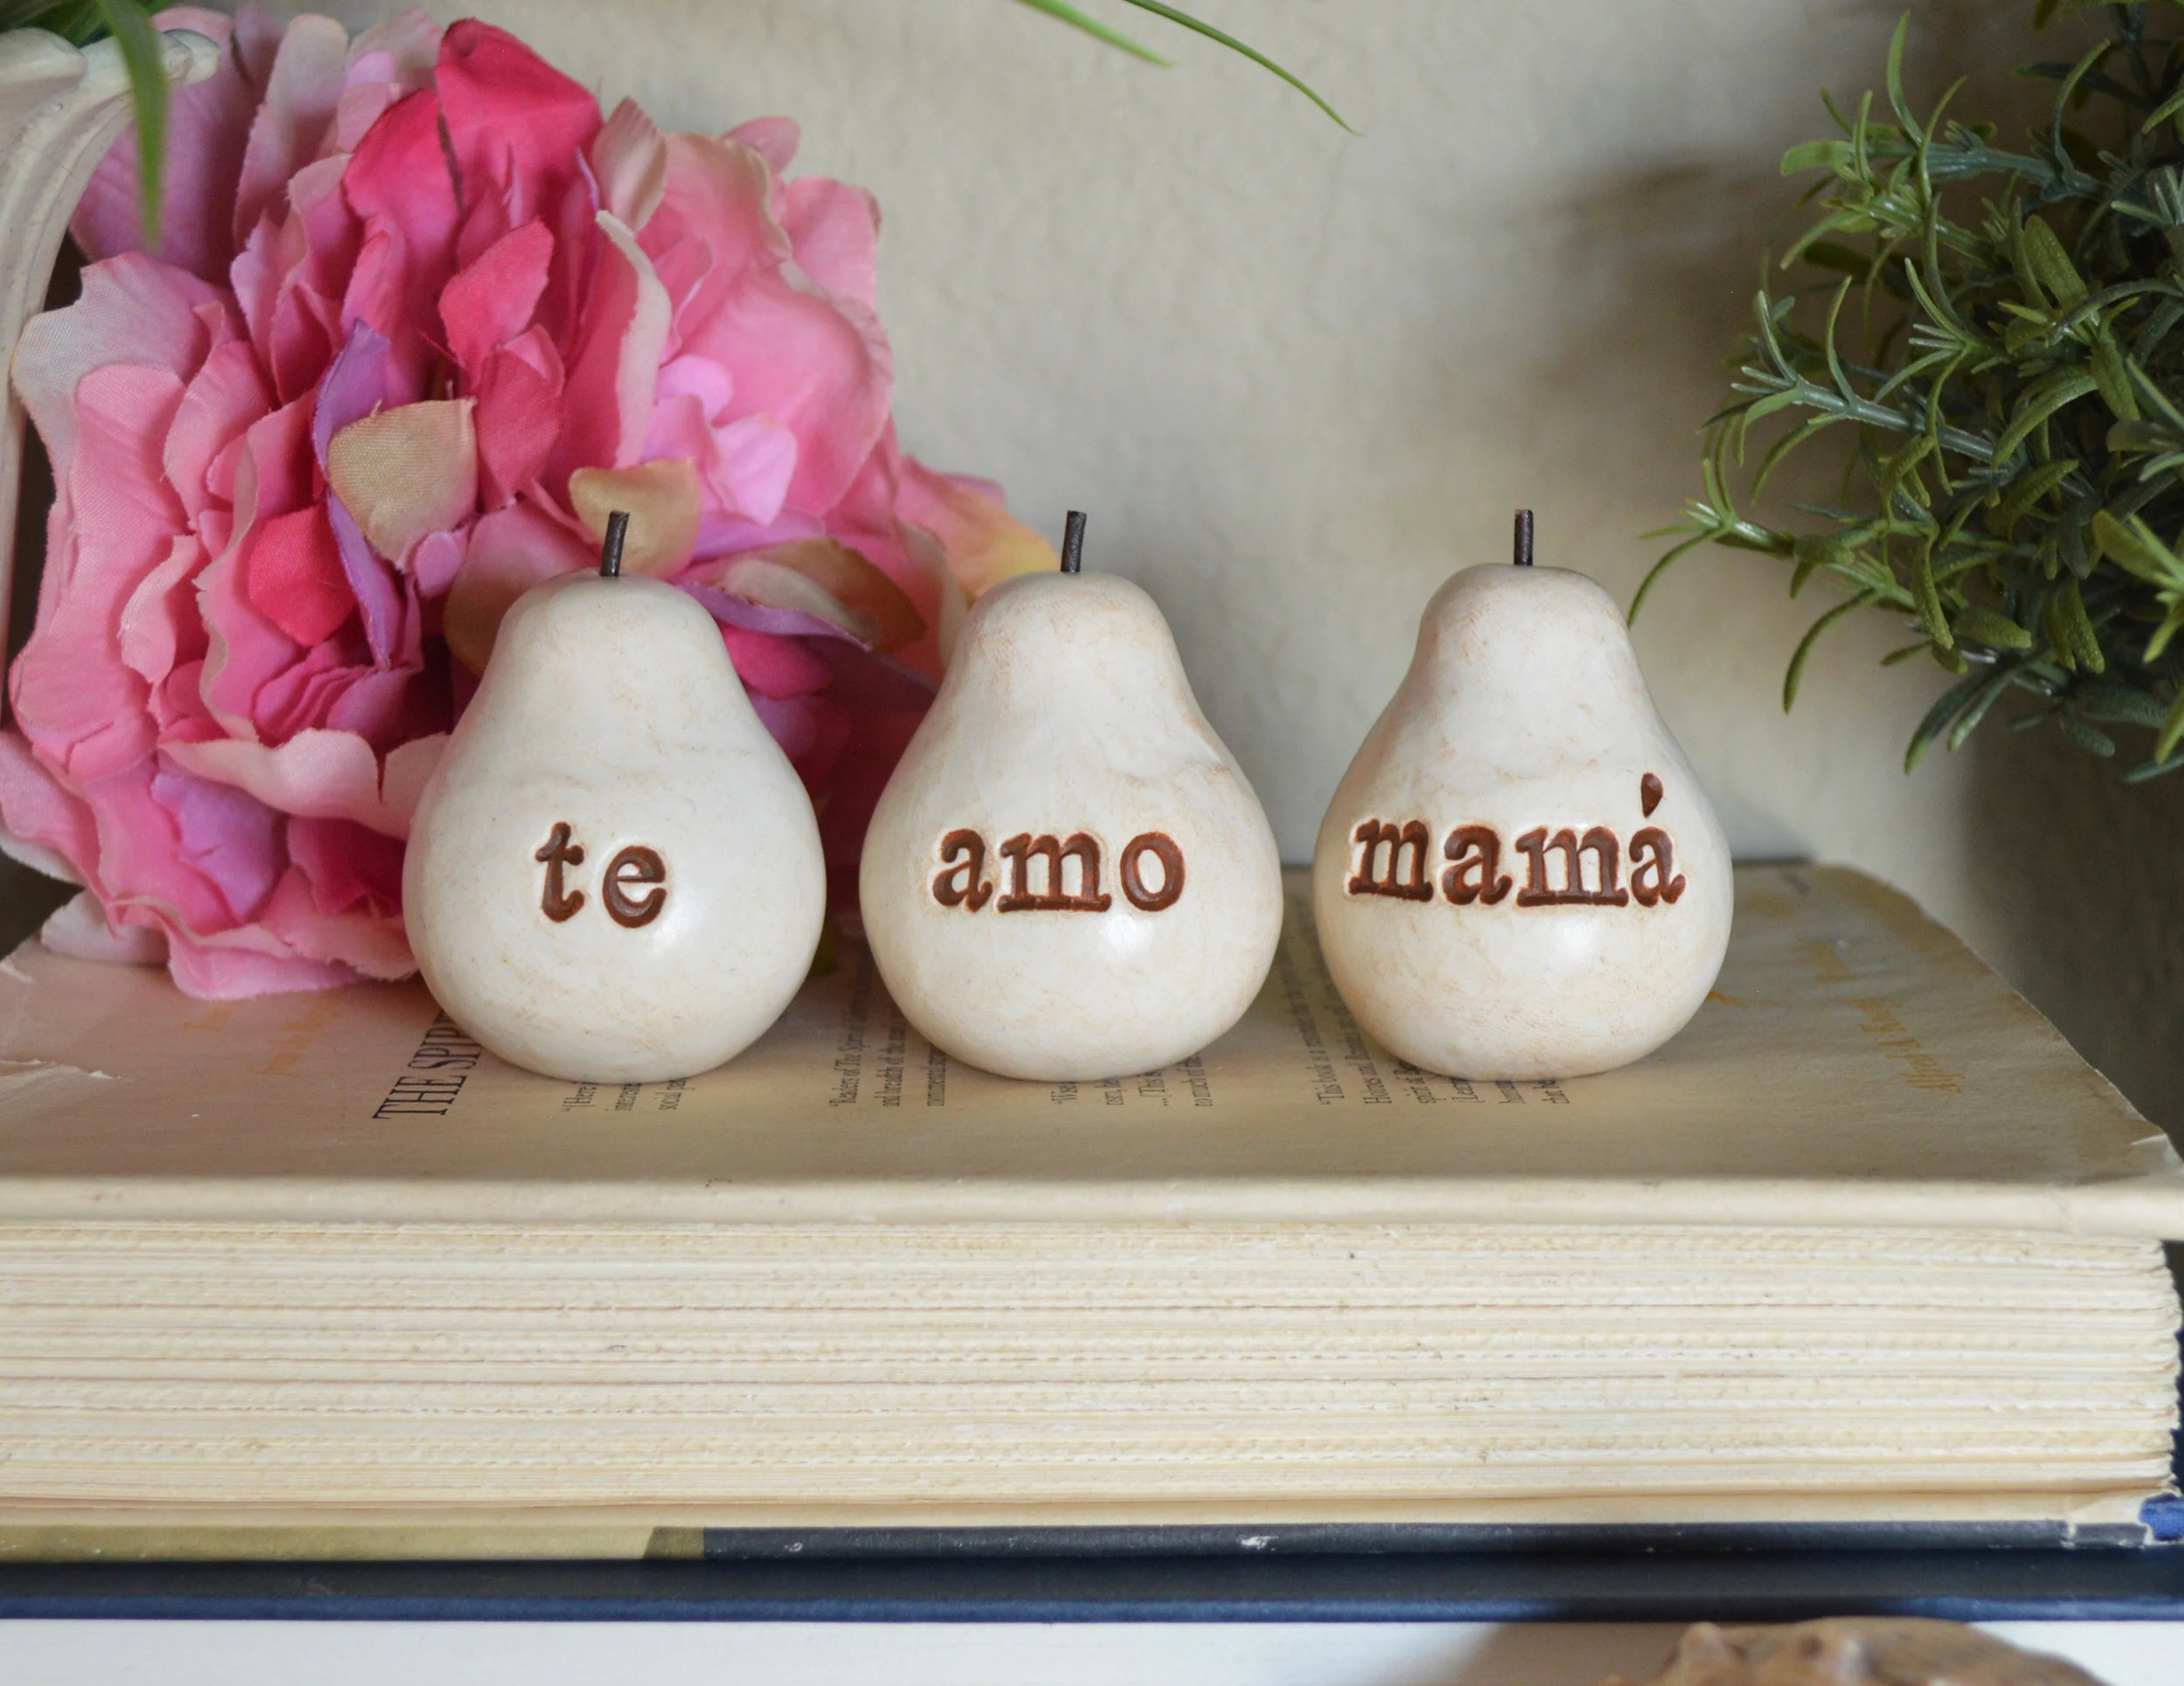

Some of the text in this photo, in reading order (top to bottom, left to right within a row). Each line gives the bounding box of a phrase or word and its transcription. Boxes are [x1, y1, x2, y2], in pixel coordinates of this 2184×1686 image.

[536, 821, 667, 929] te
[932, 827, 1185, 913] amo
[1348, 772, 1686, 908] mamá
[372, 1009, 483, 1119] THE SPIR
